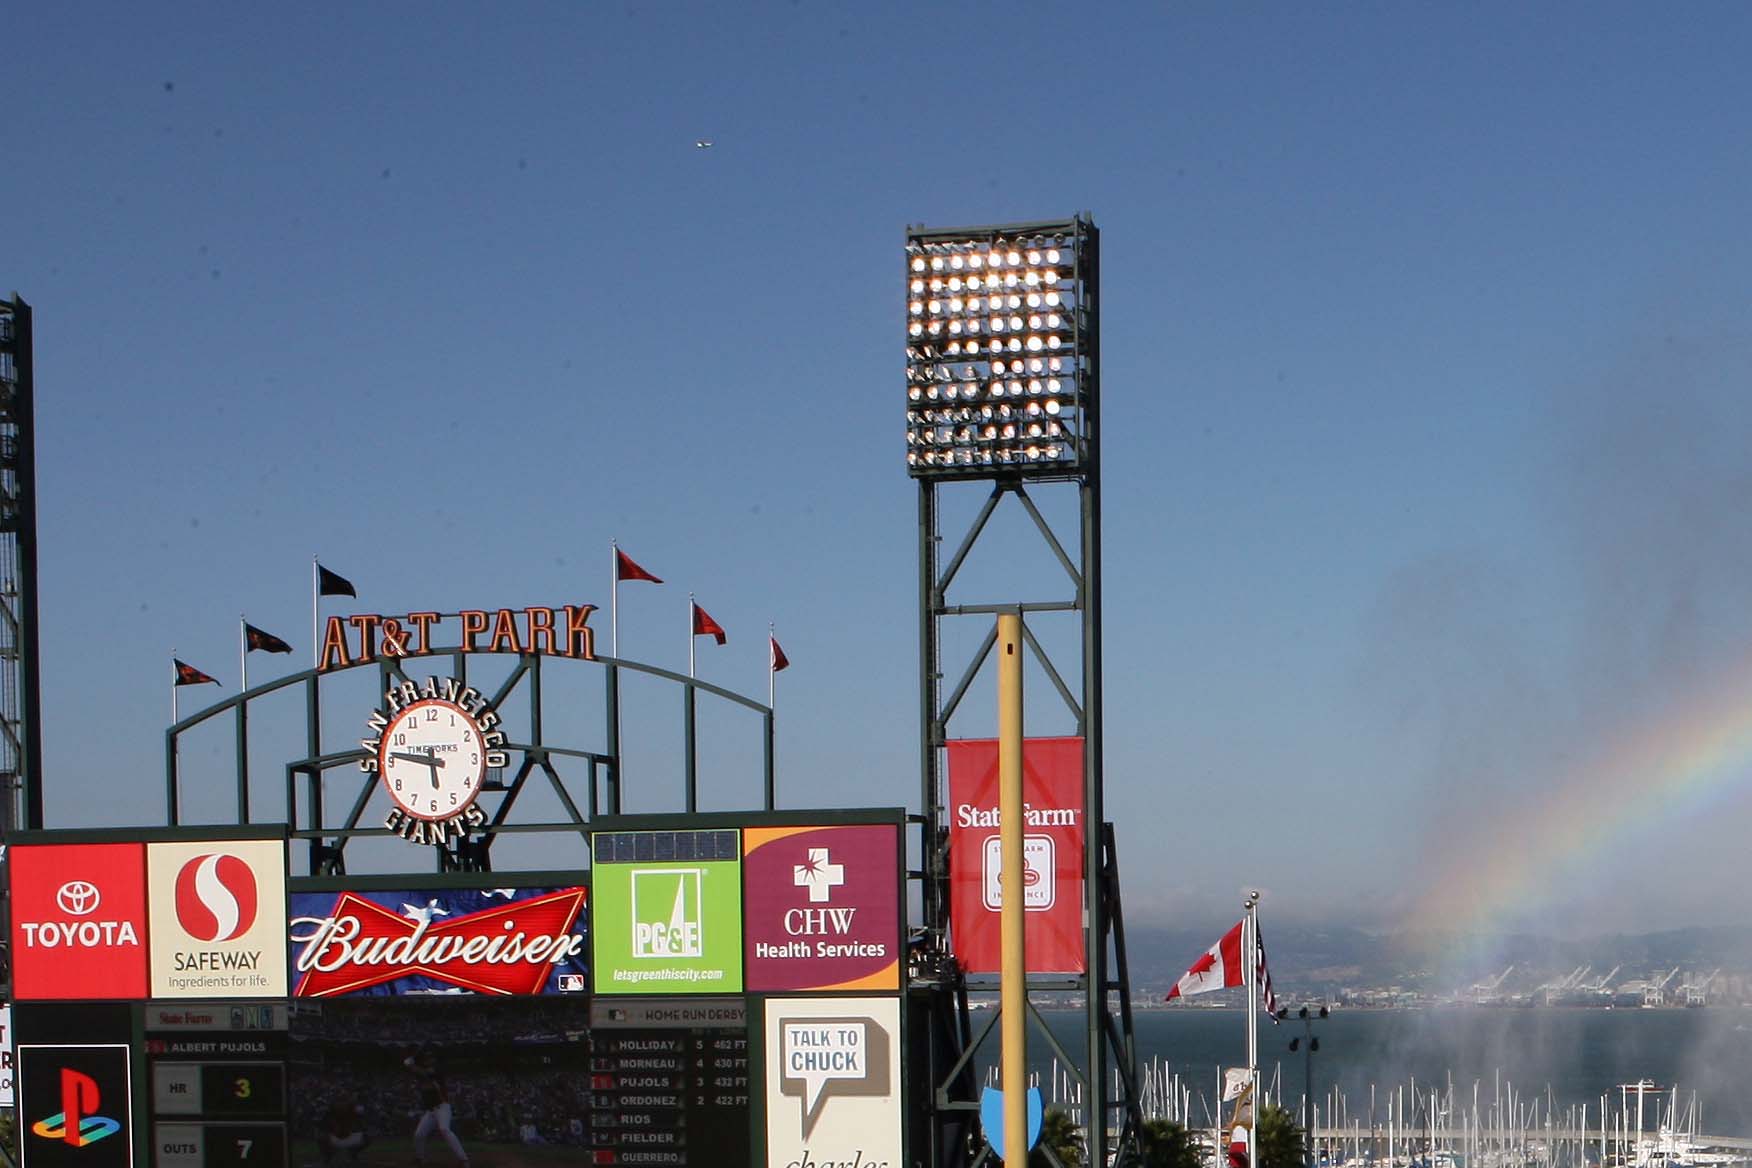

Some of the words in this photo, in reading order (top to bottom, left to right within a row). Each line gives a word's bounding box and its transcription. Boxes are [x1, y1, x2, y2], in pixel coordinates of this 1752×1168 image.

[317, 611, 441, 672] AT&T
[459, 604, 596, 660] PARK
[425, 708, 439, 723] 12
[449, 713, 456, 727] 1
[359, 707, 389, 773] SAN
[385, 674, 511, 769] FRANCISCO
[407, 716, 418, 730] 11
[392, 733, 406, 746] 10
[463, 729, 471, 744] 2
[387, 755, 395, 768] 9
[471, 752, 478, 766] 3
[395, 778, 402, 792] 8
[463, 776, 471, 789] 4
[410, 793, 418, 807] 7
[430, 798, 437, 812] 6
[449, 792, 458, 806] 5
[957, 804, 1001, 827] Stat
[383, 802, 486, 846] GIANTS
[784, 907, 857, 937] CHW
[21, 921, 139, 948] TOYOTA
[291, 908, 583, 973] Budweiser
[636, 921, 700, 954] PG&E
[755, 941, 811, 959] Health
[816, 941, 886, 959] Services
[174, 951, 261, 971] SAFEWAY
[612, 967, 724, 984] letsgreenthiscity.com
[168, 976, 230, 990] Ingredients
[231, 976, 248, 987] for
[249, 976, 270, 988] life.
[646, 1009, 680, 1021] HOME
[682, 1009, 707, 1020] RUN
[708, 1009, 746, 1020] DERBY
[619, 1040, 676, 1050] HOLLIDAY
[696, 1040, 704, 1049] 5
[734, 1040, 747, 1049] FT
[790, 1029, 830, 1047] TALK
[836, 1029, 859, 1047] TO
[171, 1042, 217, 1053] ALBERT
[220, 1042, 267, 1053] PUJOLS
[619, 1058, 676, 1069] MORNEAU
[696, 1058, 704, 1068] 4
[735, 1058, 748, 1068] FT
[790, 1051, 859, 1072] CHUCK
[169, 1082, 187, 1094] HR
[234, 1078, 252, 1099] 3
[620, 1077, 670, 1087] PUJOLS
[697, 1077, 704, 1087] 3
[736, 1077, 748, 1087] FT
[620, 1096, 677, 1106] ORDONEZ
[697, 1096, 705, 1105] 2
[736, 1096, 748, 1106] FT
[620, 1115, 652, 1124] RIOS
[621, 1133, 674, 1143] FIELDER
[163, 1143, 197, 1154] OUTS
[236, 1139, 253, 1160] 7
[621, 1152, 679, 1163] GUERRERO
